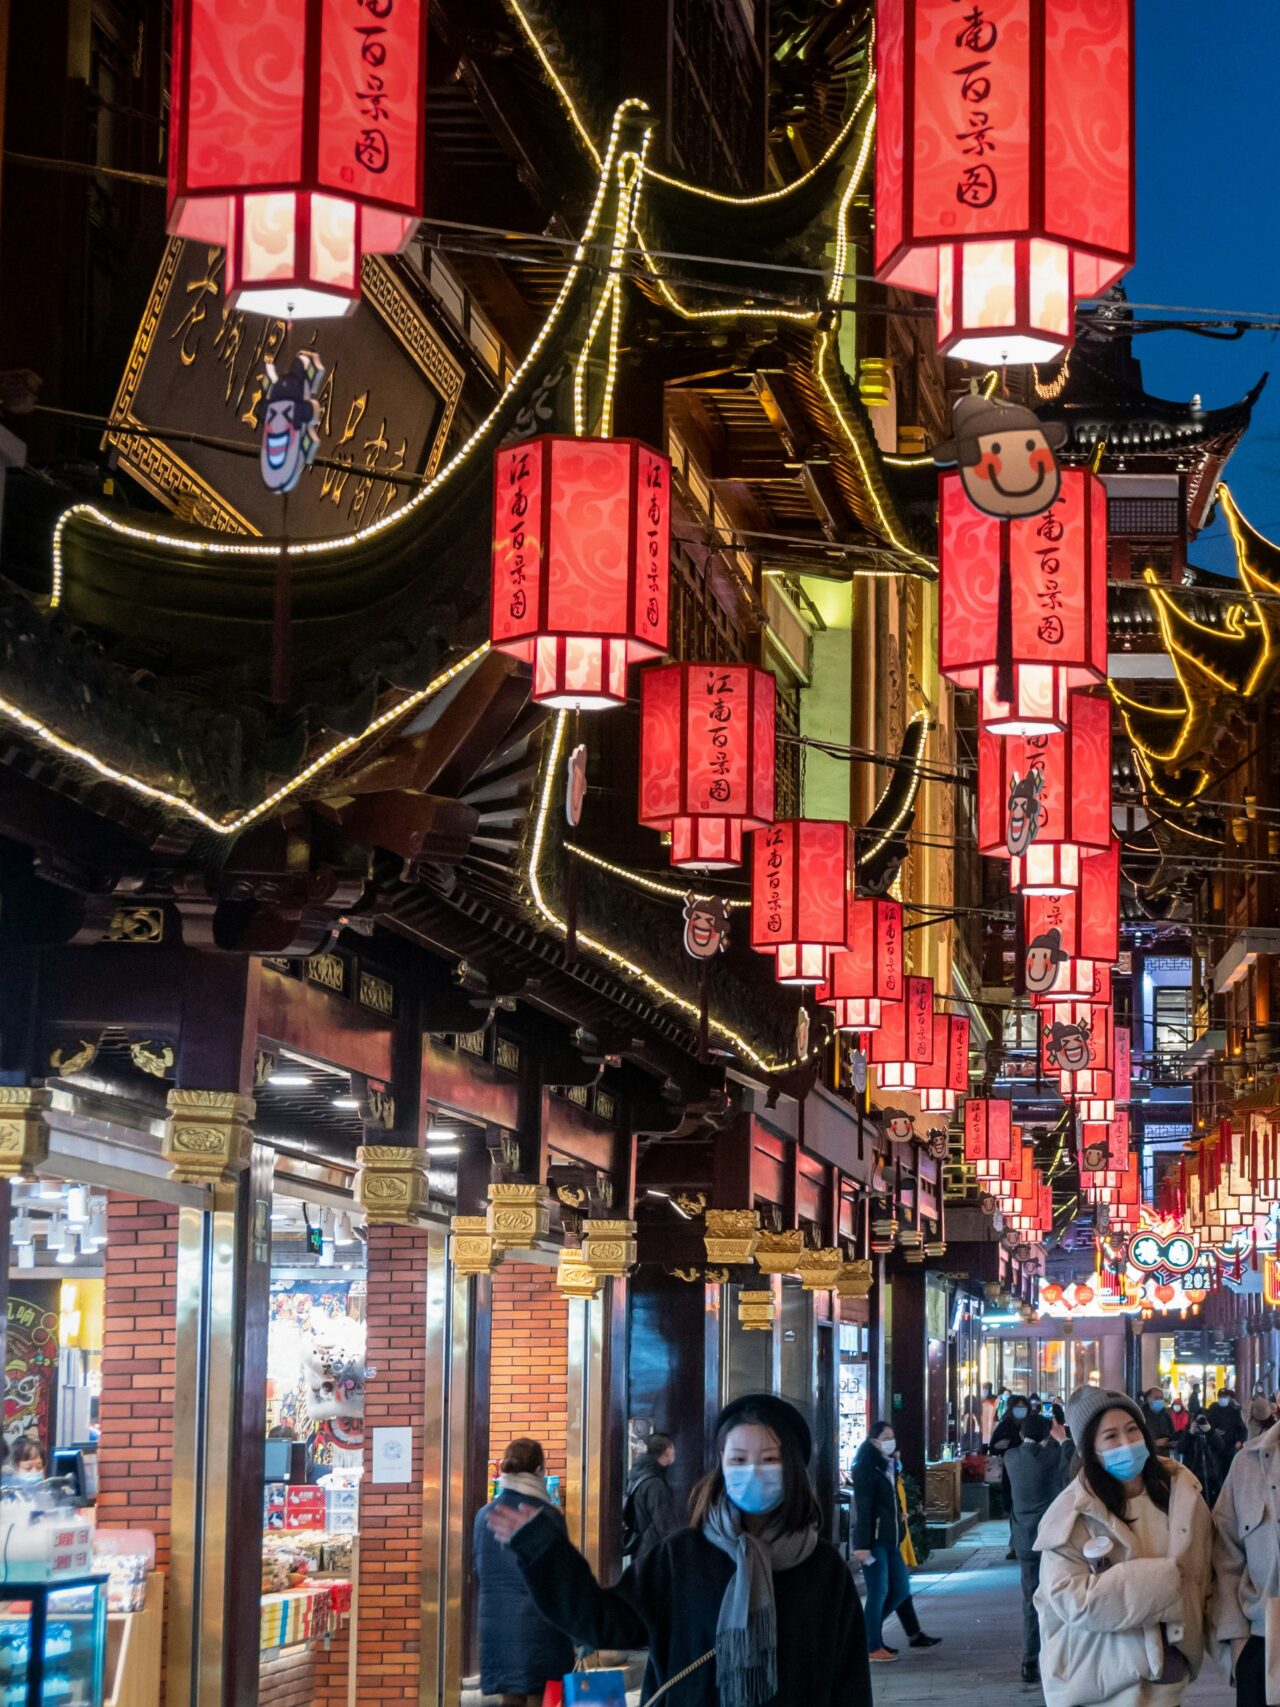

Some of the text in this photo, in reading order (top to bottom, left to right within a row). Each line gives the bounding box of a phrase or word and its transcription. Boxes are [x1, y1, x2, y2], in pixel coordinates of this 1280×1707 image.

[509, 453, 530, 619] 江南百景图
[645, 458, 662, 628] 江南百景图
[1035, 497, 1065, 645] 南百景图
[706, 671, 734, 802] 江南百景图
[766, 828, 783, 932] 江南百景图
[885, 906, 897, 990] 江南百景图
